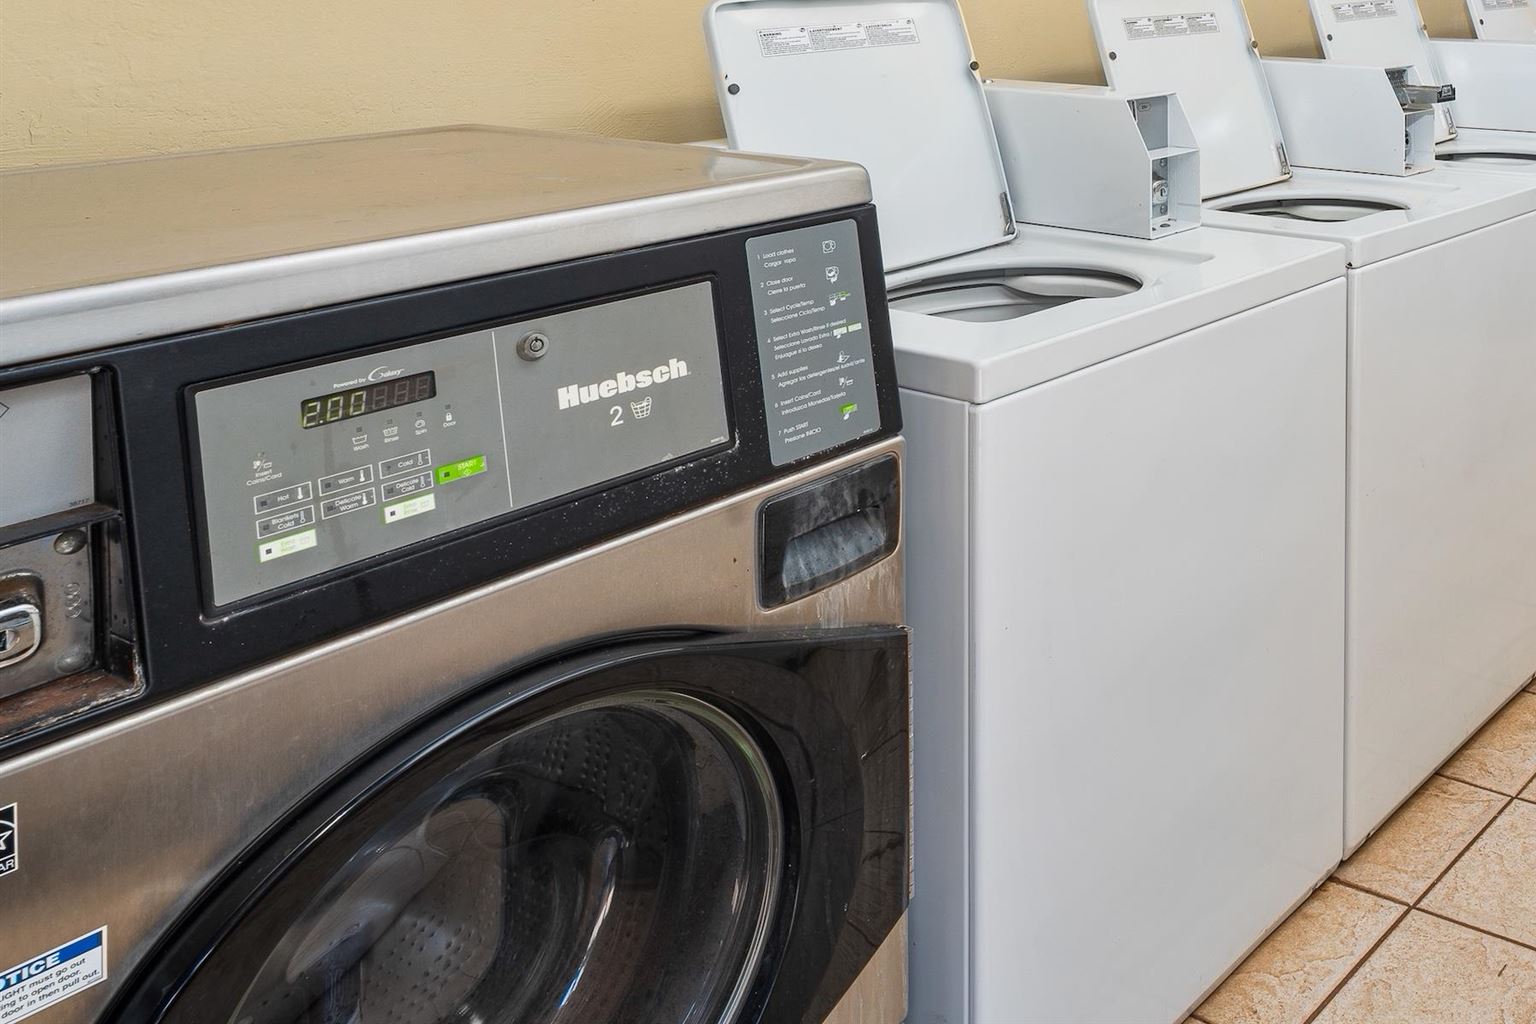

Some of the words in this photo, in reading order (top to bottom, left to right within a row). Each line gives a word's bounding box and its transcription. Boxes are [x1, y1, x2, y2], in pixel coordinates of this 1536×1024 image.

[762, 251, 777, 259] Load
[776, 248, 795, 257] clothes
[766, 278, 781, 287] Close
[781, 276, 794, 284] door
[789, 282, 806, 292] puerta
[769, 306, 785, 315] Select
[773, 333, 788, 343] Select
[333, 379, 358, 389] Powered
[358, 377, 367, 385] by
[367, 365, 405, 382] Galaxy
[777, 371, 788, 379] Add
[789, 365, 809, 376] supplies
[557, 358, 688, 410] Huebsch
[780, 397, 794, 406] Insert
[609, 405, 624, 427] 2
[443, 420, 457, 428] Door
[783, 426, 796, 435] Push
[397, 459, 414, 468] Cold
[457, 459, 477, 471] START
[246, 472, 283, 486] Coins/Card
[255, 469, 273, 478] Insert
[337, 476, 355, 484] Warm
[395, 478, 420, 489] Delicate
[401, 485, 415, 493] Cold
[277, 494, 290, 503] Hot
[334, 494, 362, 507] Delicate
[339, 502, 359, 511] Warm
[271, 512, 300, 525] Blankets
[277, 520, 295, 530] Cold
[29, 973, 53, 988] must
[55, 966, 68, 978] go
[70, 958, 86, 969] out
[18, 993, 29, 1001] to
[31, 981, 55, 996] open
[57, 969, 81, 984] door.
[1, 1004, 24, 1019] door
[26, 997, 36, 1007] in
[38, 987, 60, 1002] then
[62, 977, 80, 992] pull
[82, 969, 100, 981] out.
